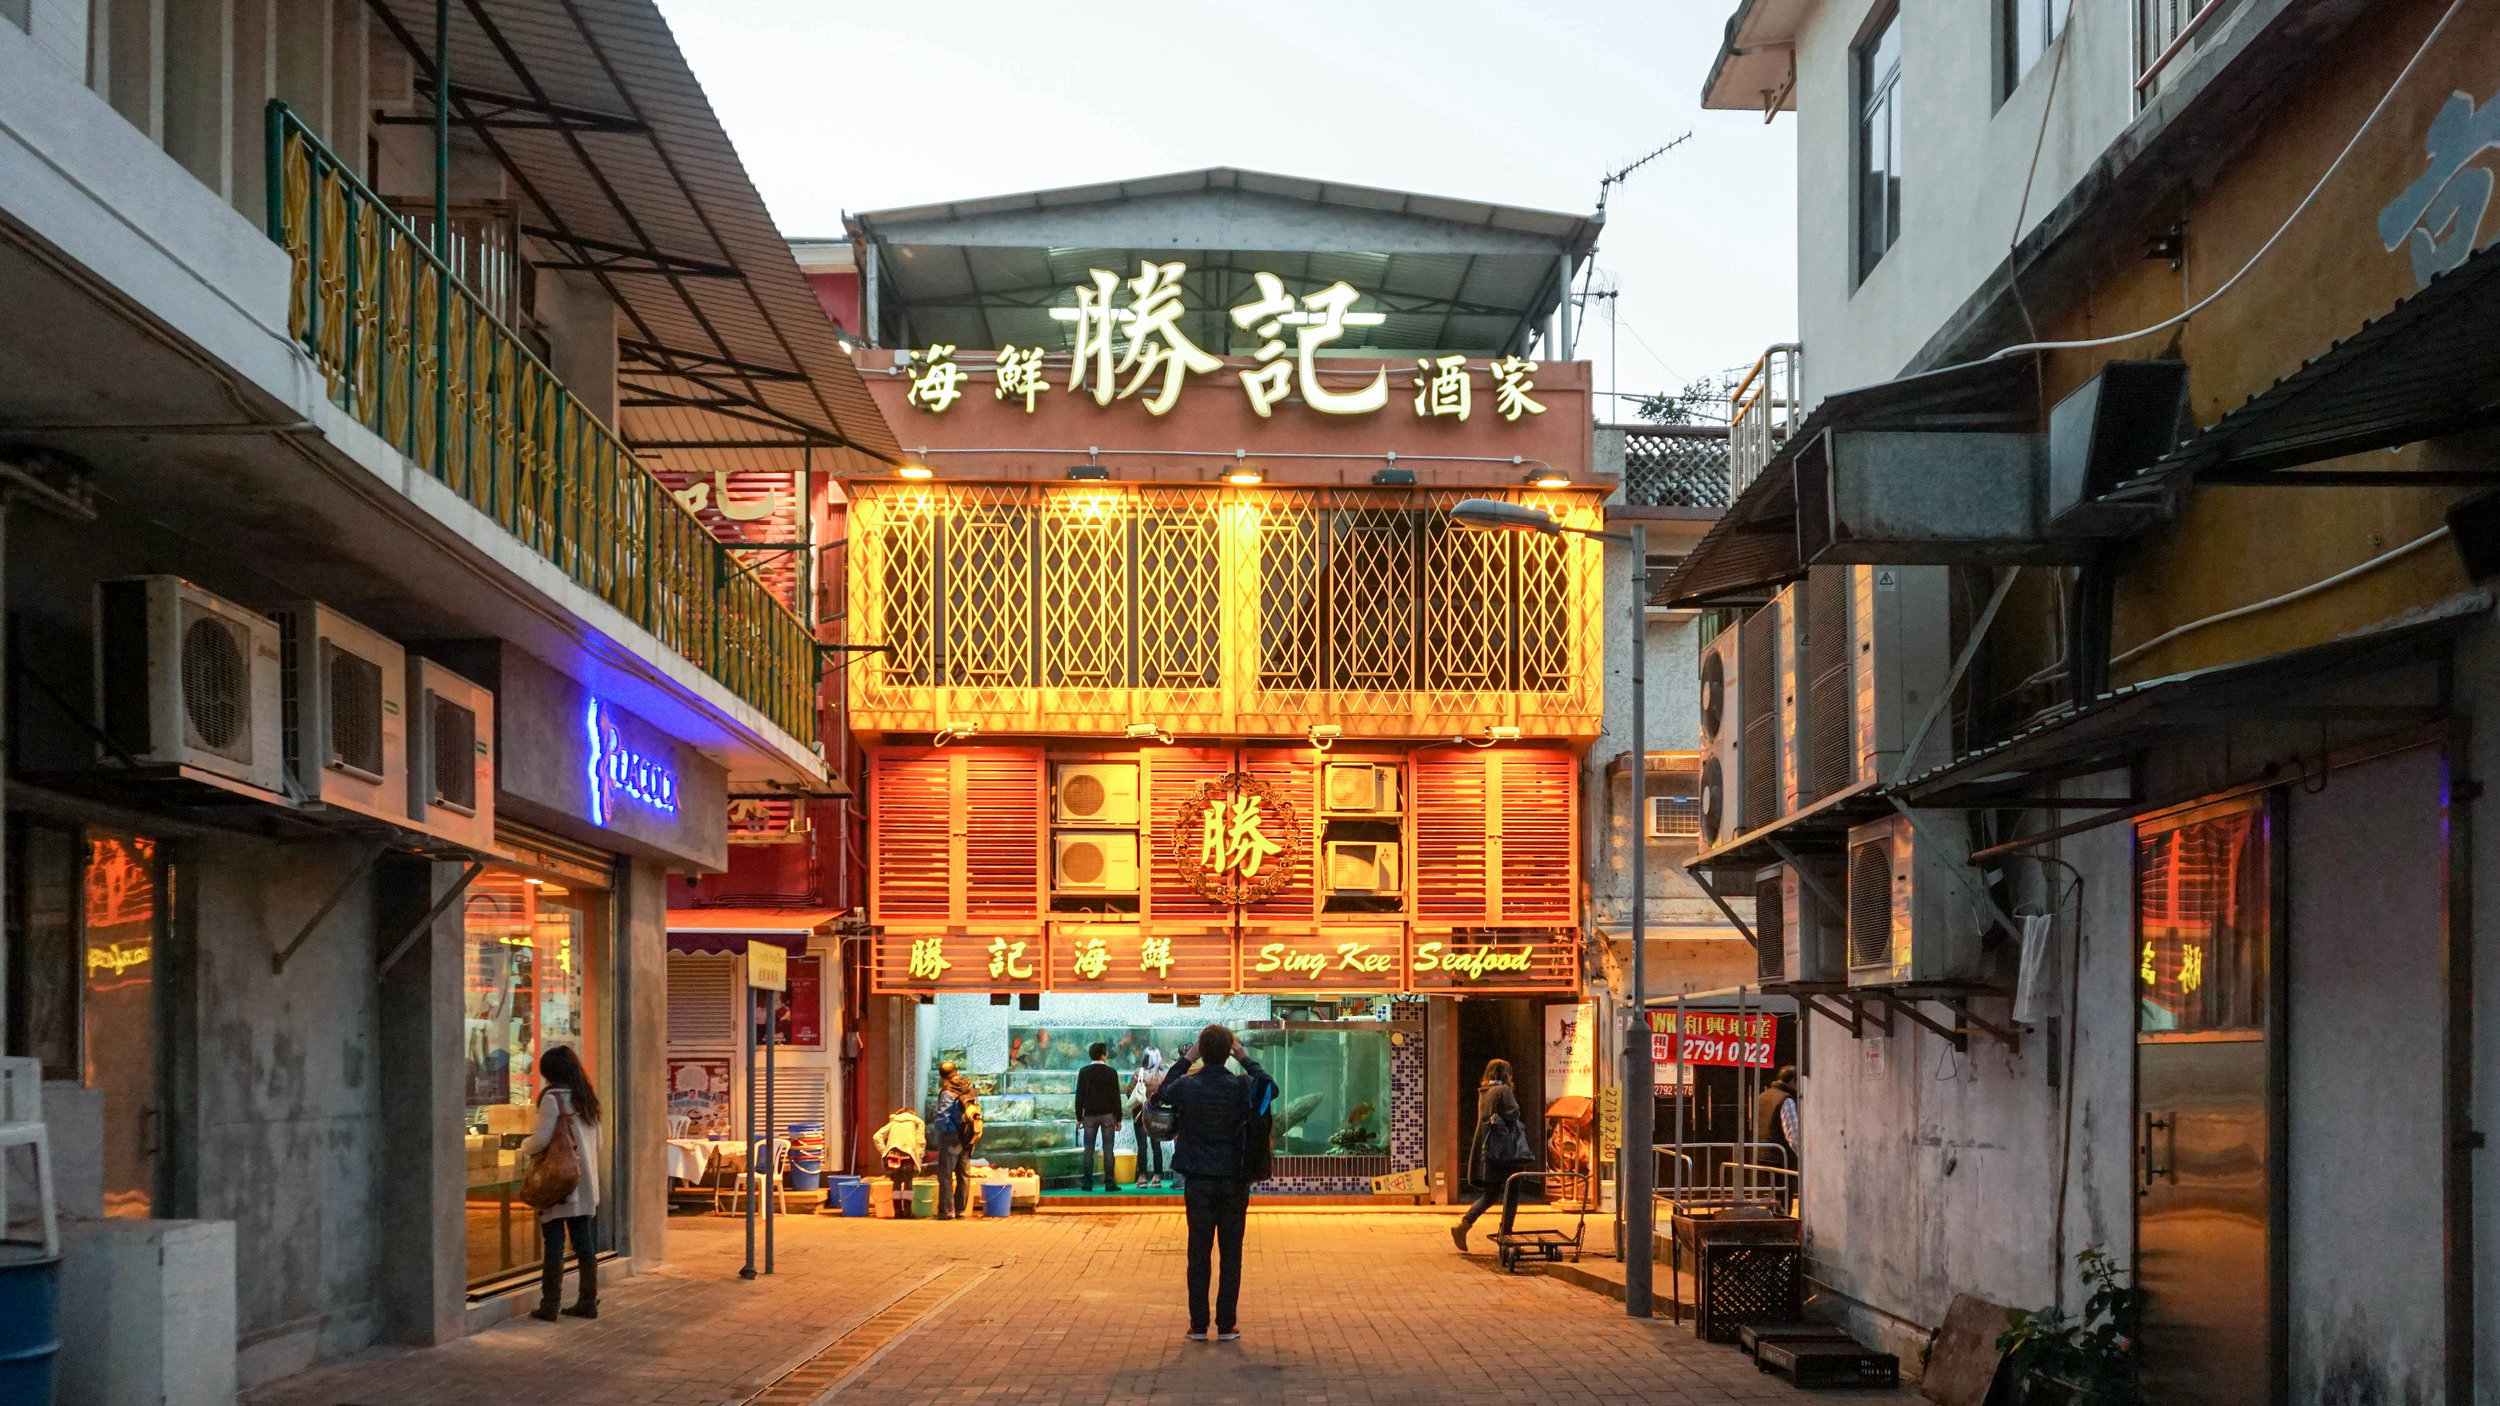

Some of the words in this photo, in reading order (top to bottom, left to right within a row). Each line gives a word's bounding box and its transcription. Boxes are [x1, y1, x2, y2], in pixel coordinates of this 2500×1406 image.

[908, 344, 1050, 413] 海鮮
[1068, 260, 1388, 418] 勝記
[1413, 355, 1547, 421] 酒家
[1201, 795, 1282, 878] 勝
[1255, 943, 1327, 980] Sing
[1337, 942, 1392, 973] Kee
[1414, 942, 1532, 980] Seafood
[1683, 1039, 1724, 1061] 2791
[1604, 1090, 1617, 1123] 2719
[1654, 1085, 1673, 1096] 2792
[1674, 1085, 1693, 1096] 78
[1604, 1126, 1617, 1160] 2280
